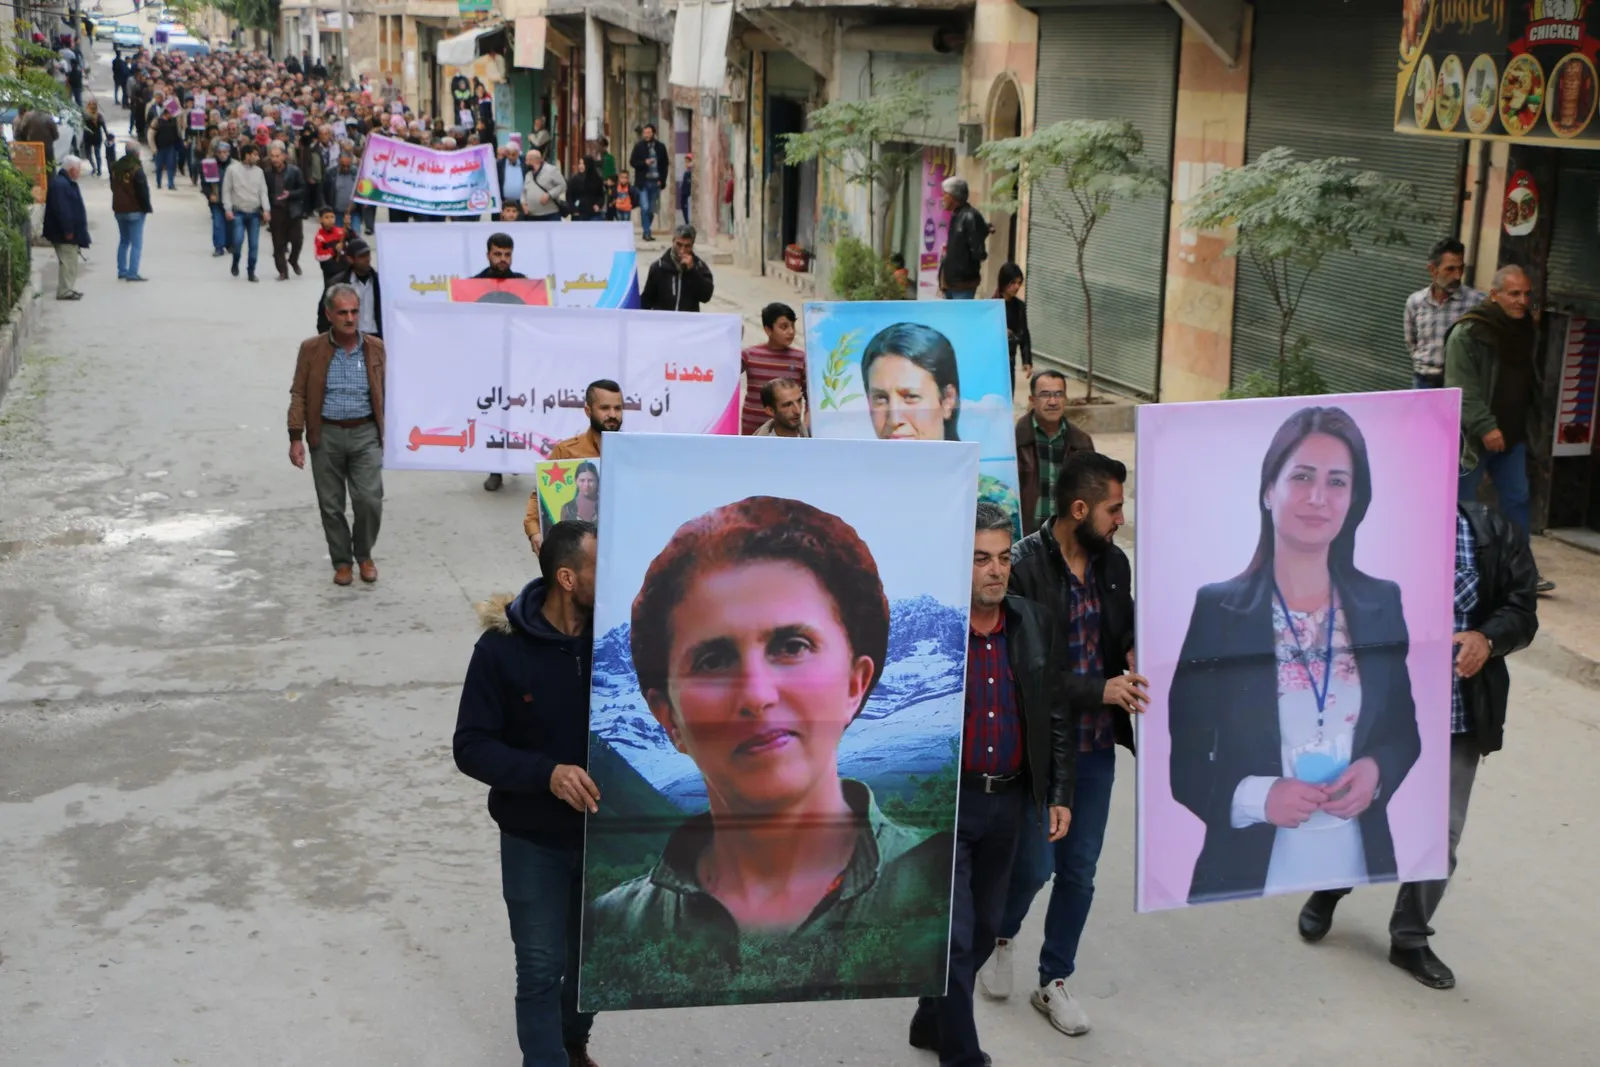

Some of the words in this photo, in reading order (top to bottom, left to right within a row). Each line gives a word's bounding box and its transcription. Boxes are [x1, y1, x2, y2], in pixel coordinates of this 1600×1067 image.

[1529, 24, 1581, 41] CHICKEN
[665, 362, 714, 382] عهدنا
[476, 386, 535, 415] إمرالي
[543, 388, 586, 414] نظام
[650, 387, 670, 417] أن
[406, 418, 476, 453] آبو
[486, 431, 532, 450] القائد
